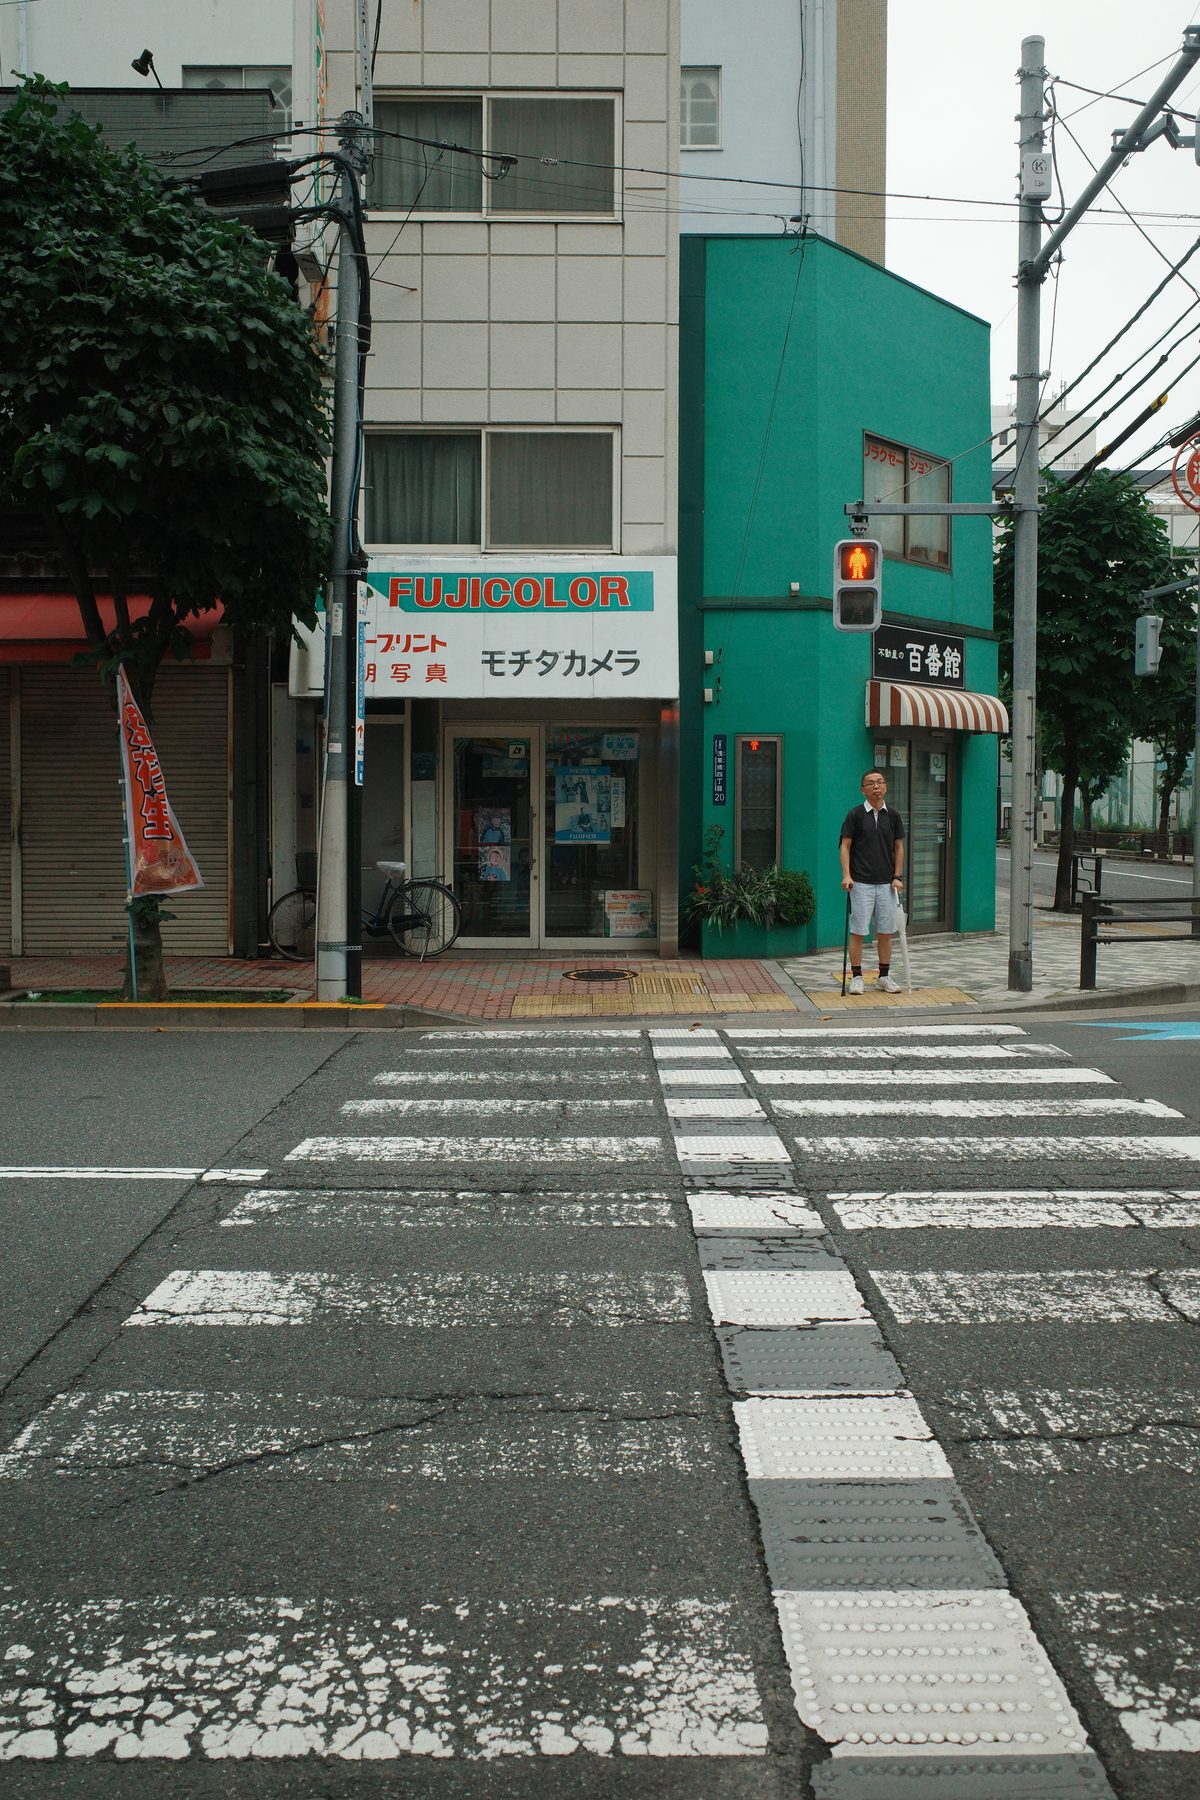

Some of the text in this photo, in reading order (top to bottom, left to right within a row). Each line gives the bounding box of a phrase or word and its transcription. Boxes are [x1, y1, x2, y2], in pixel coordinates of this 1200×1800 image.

[389, 576, 632, 608] FUJICOLOR
[481, 648, 641, 677] モチダカメラ
[877, 642, 962, 679] 不動産の 百番館
[715, 793, 725, 802] 20
